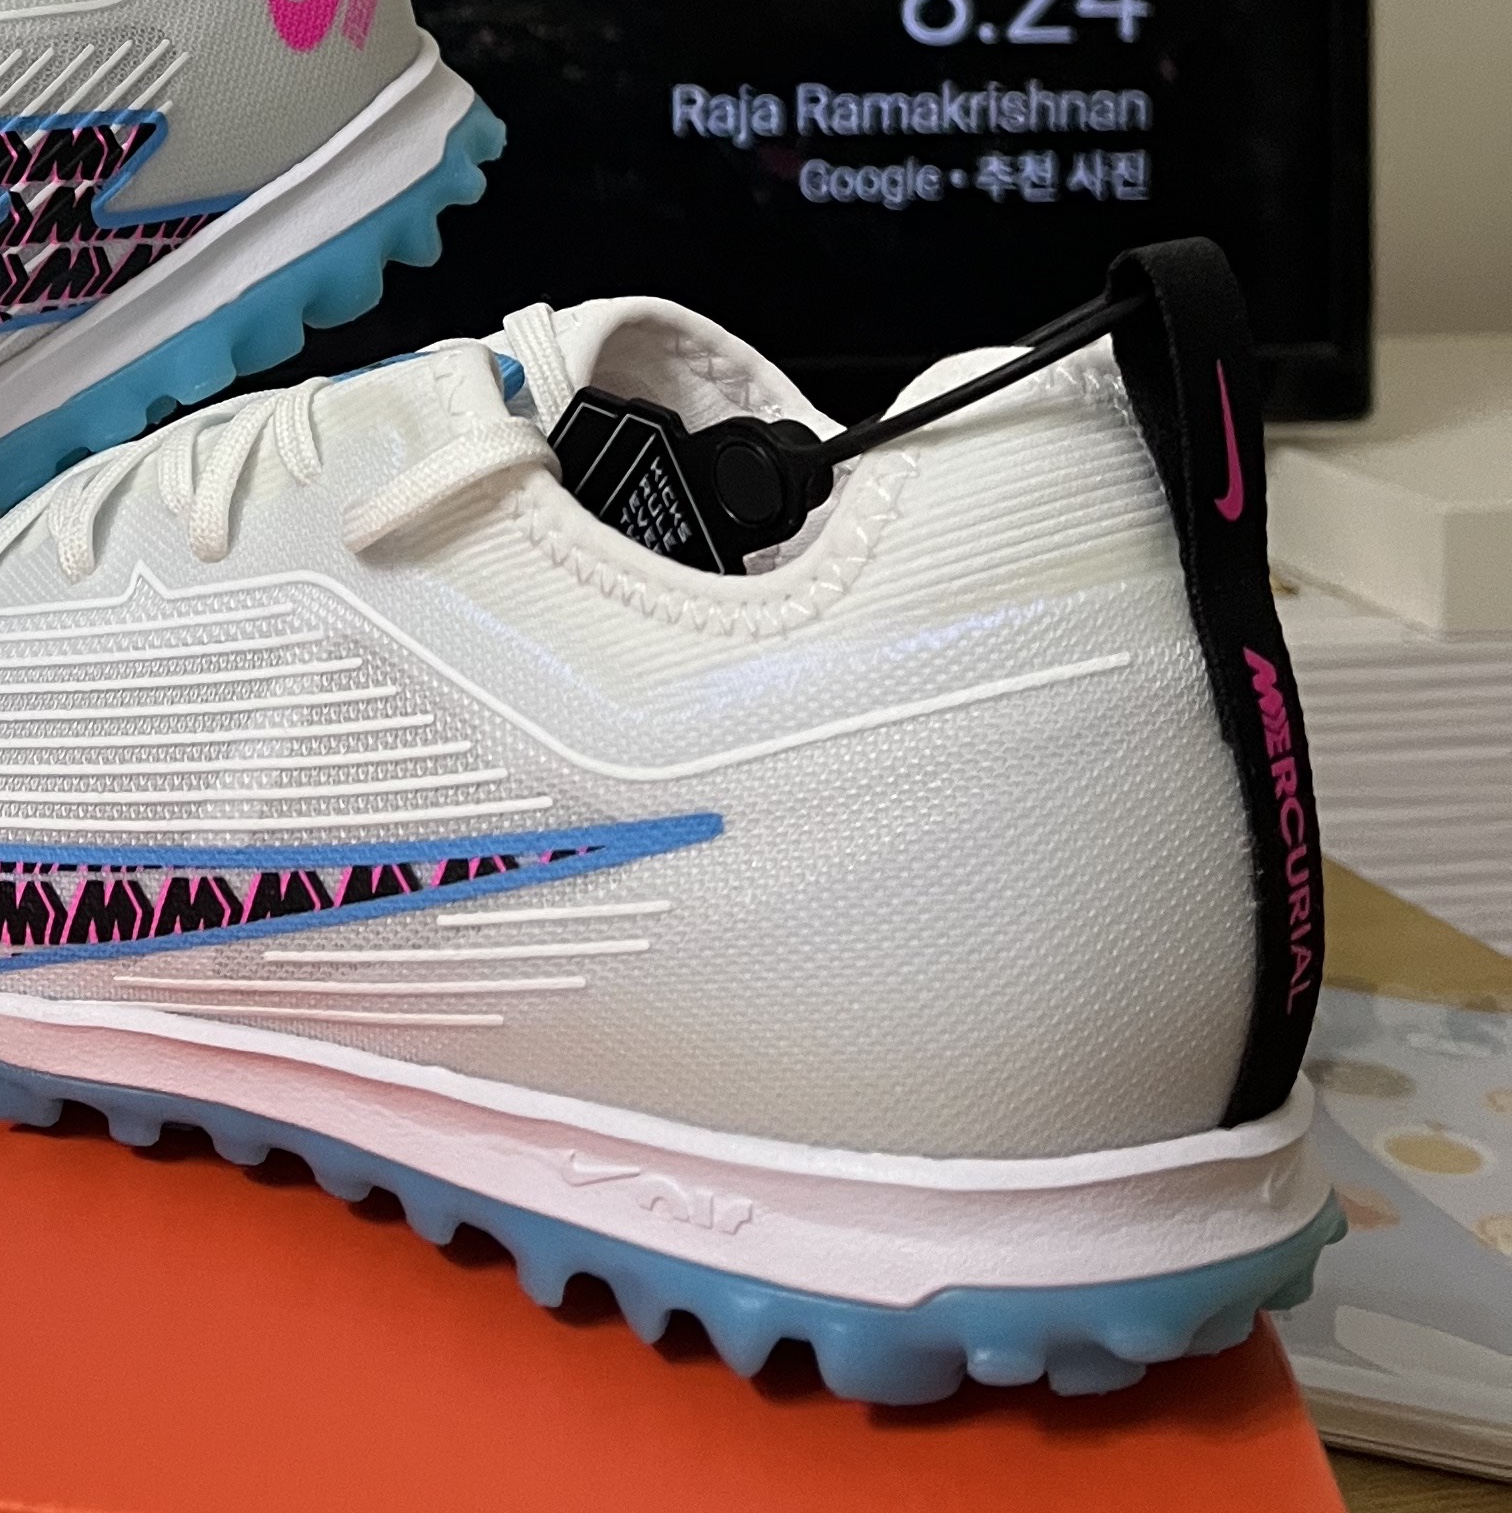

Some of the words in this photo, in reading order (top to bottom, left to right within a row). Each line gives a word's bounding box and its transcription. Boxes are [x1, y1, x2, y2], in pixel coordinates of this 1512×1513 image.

[672, 83, 784, 147] Raja
[796, 79, 1153, 136] Ramakrishnan
[800, 155, 944, 210] Google
[977, 150, 1059, 202] 추천
[1068, 149, 1152, 201] 사진
[639, 473, 679, 552] RULE
[650, 456, 693, 544] KICKS
[1243, 646, 1312, 1015] MERCURIAL
